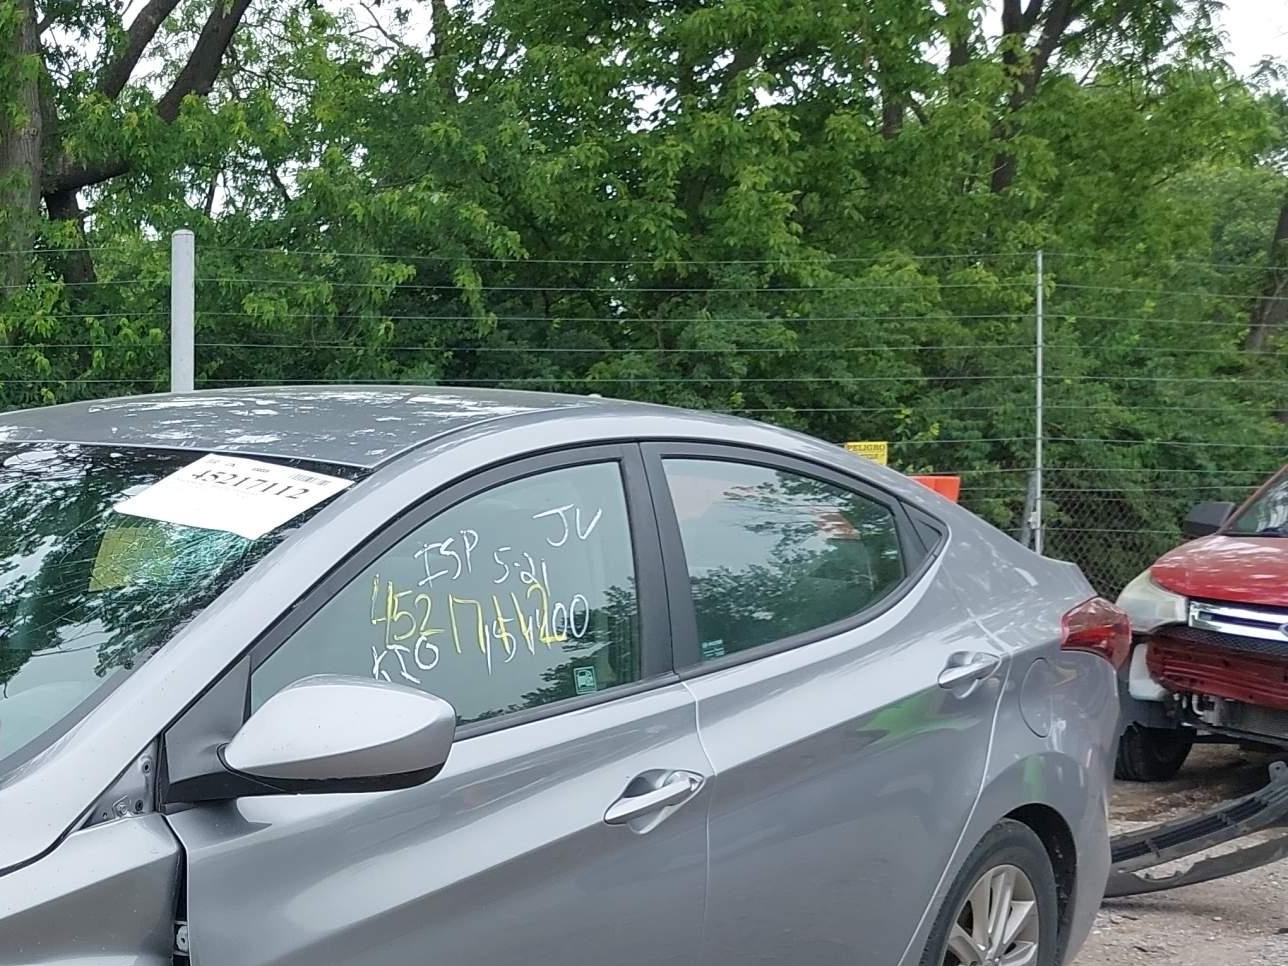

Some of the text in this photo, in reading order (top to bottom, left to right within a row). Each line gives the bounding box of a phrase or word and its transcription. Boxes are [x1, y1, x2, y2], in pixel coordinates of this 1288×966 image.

[191, 469, 310, 500] 45217112
[413, 529, 480, 588] ISP
[371, 575, 568, 655] 45217112
